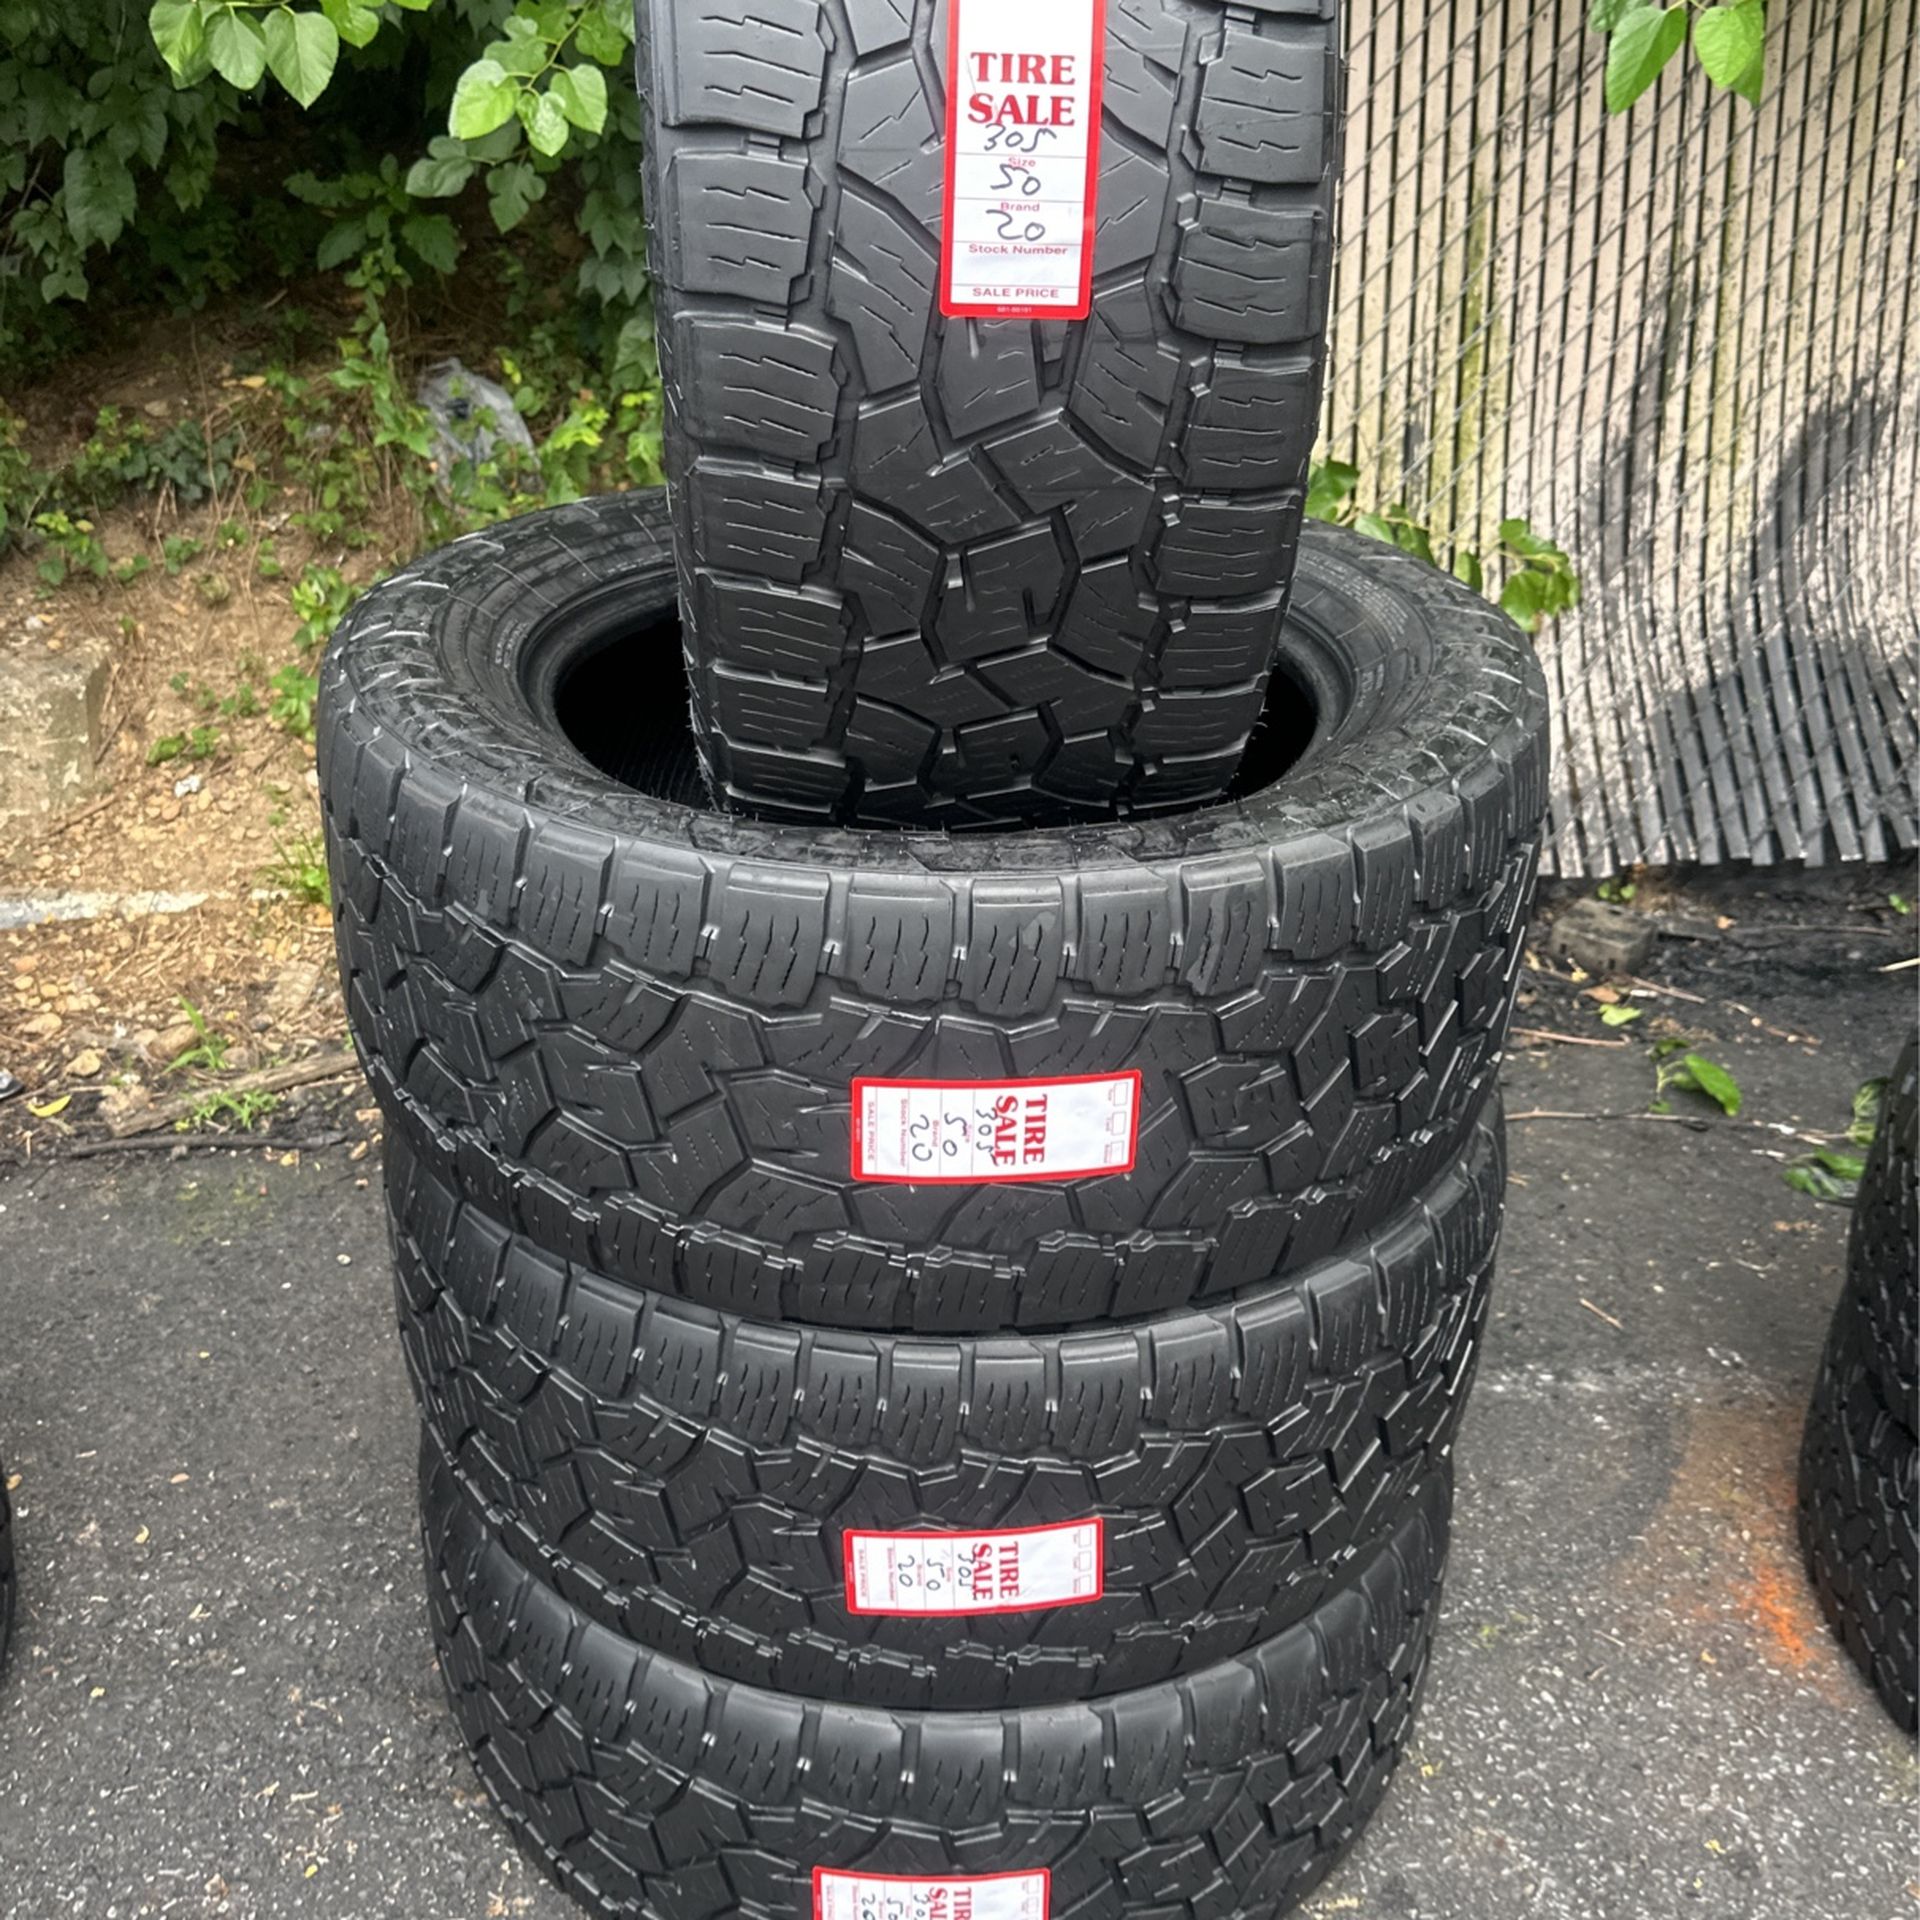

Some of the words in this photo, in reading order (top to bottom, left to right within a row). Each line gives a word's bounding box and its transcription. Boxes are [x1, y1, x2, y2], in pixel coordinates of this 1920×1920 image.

[970, 52, 1076, 86] TIRE
[967, 92, 1076, 126] SALE
[984, 122, 1058, 153] 305
[1008, 157, 1036, 168] Size
[990, 163, 1041, 196] 50
[1000, 202, 1040, 212] Brand
[985, 209, 1046, 242] 20
[968, 243, 1009, 254] Stock
[1012, 245, 1068, 255] Number
[972, 287, 1011, 297] SALE
[1015, 288, 1060, 299] PRICE
[909, 1114, 933, 1162] 20
[943, 1112, 968, 1157] 50
[976, 1107, 999, 1166] 305
[994, 1095, 1019, 1166] SALE
[1023, 1093, 1048, 1165] TIRE
[898, 1554, 915, 1587] 20
[926, 1558, 945, 1591] 50
[972, 1543, 993, 1600] SALE
[999, 1541, 1019, 1599] TIRE
[929, 1886, 948, 1920] SAL
[954, 1887, 972, 1920] TIR
